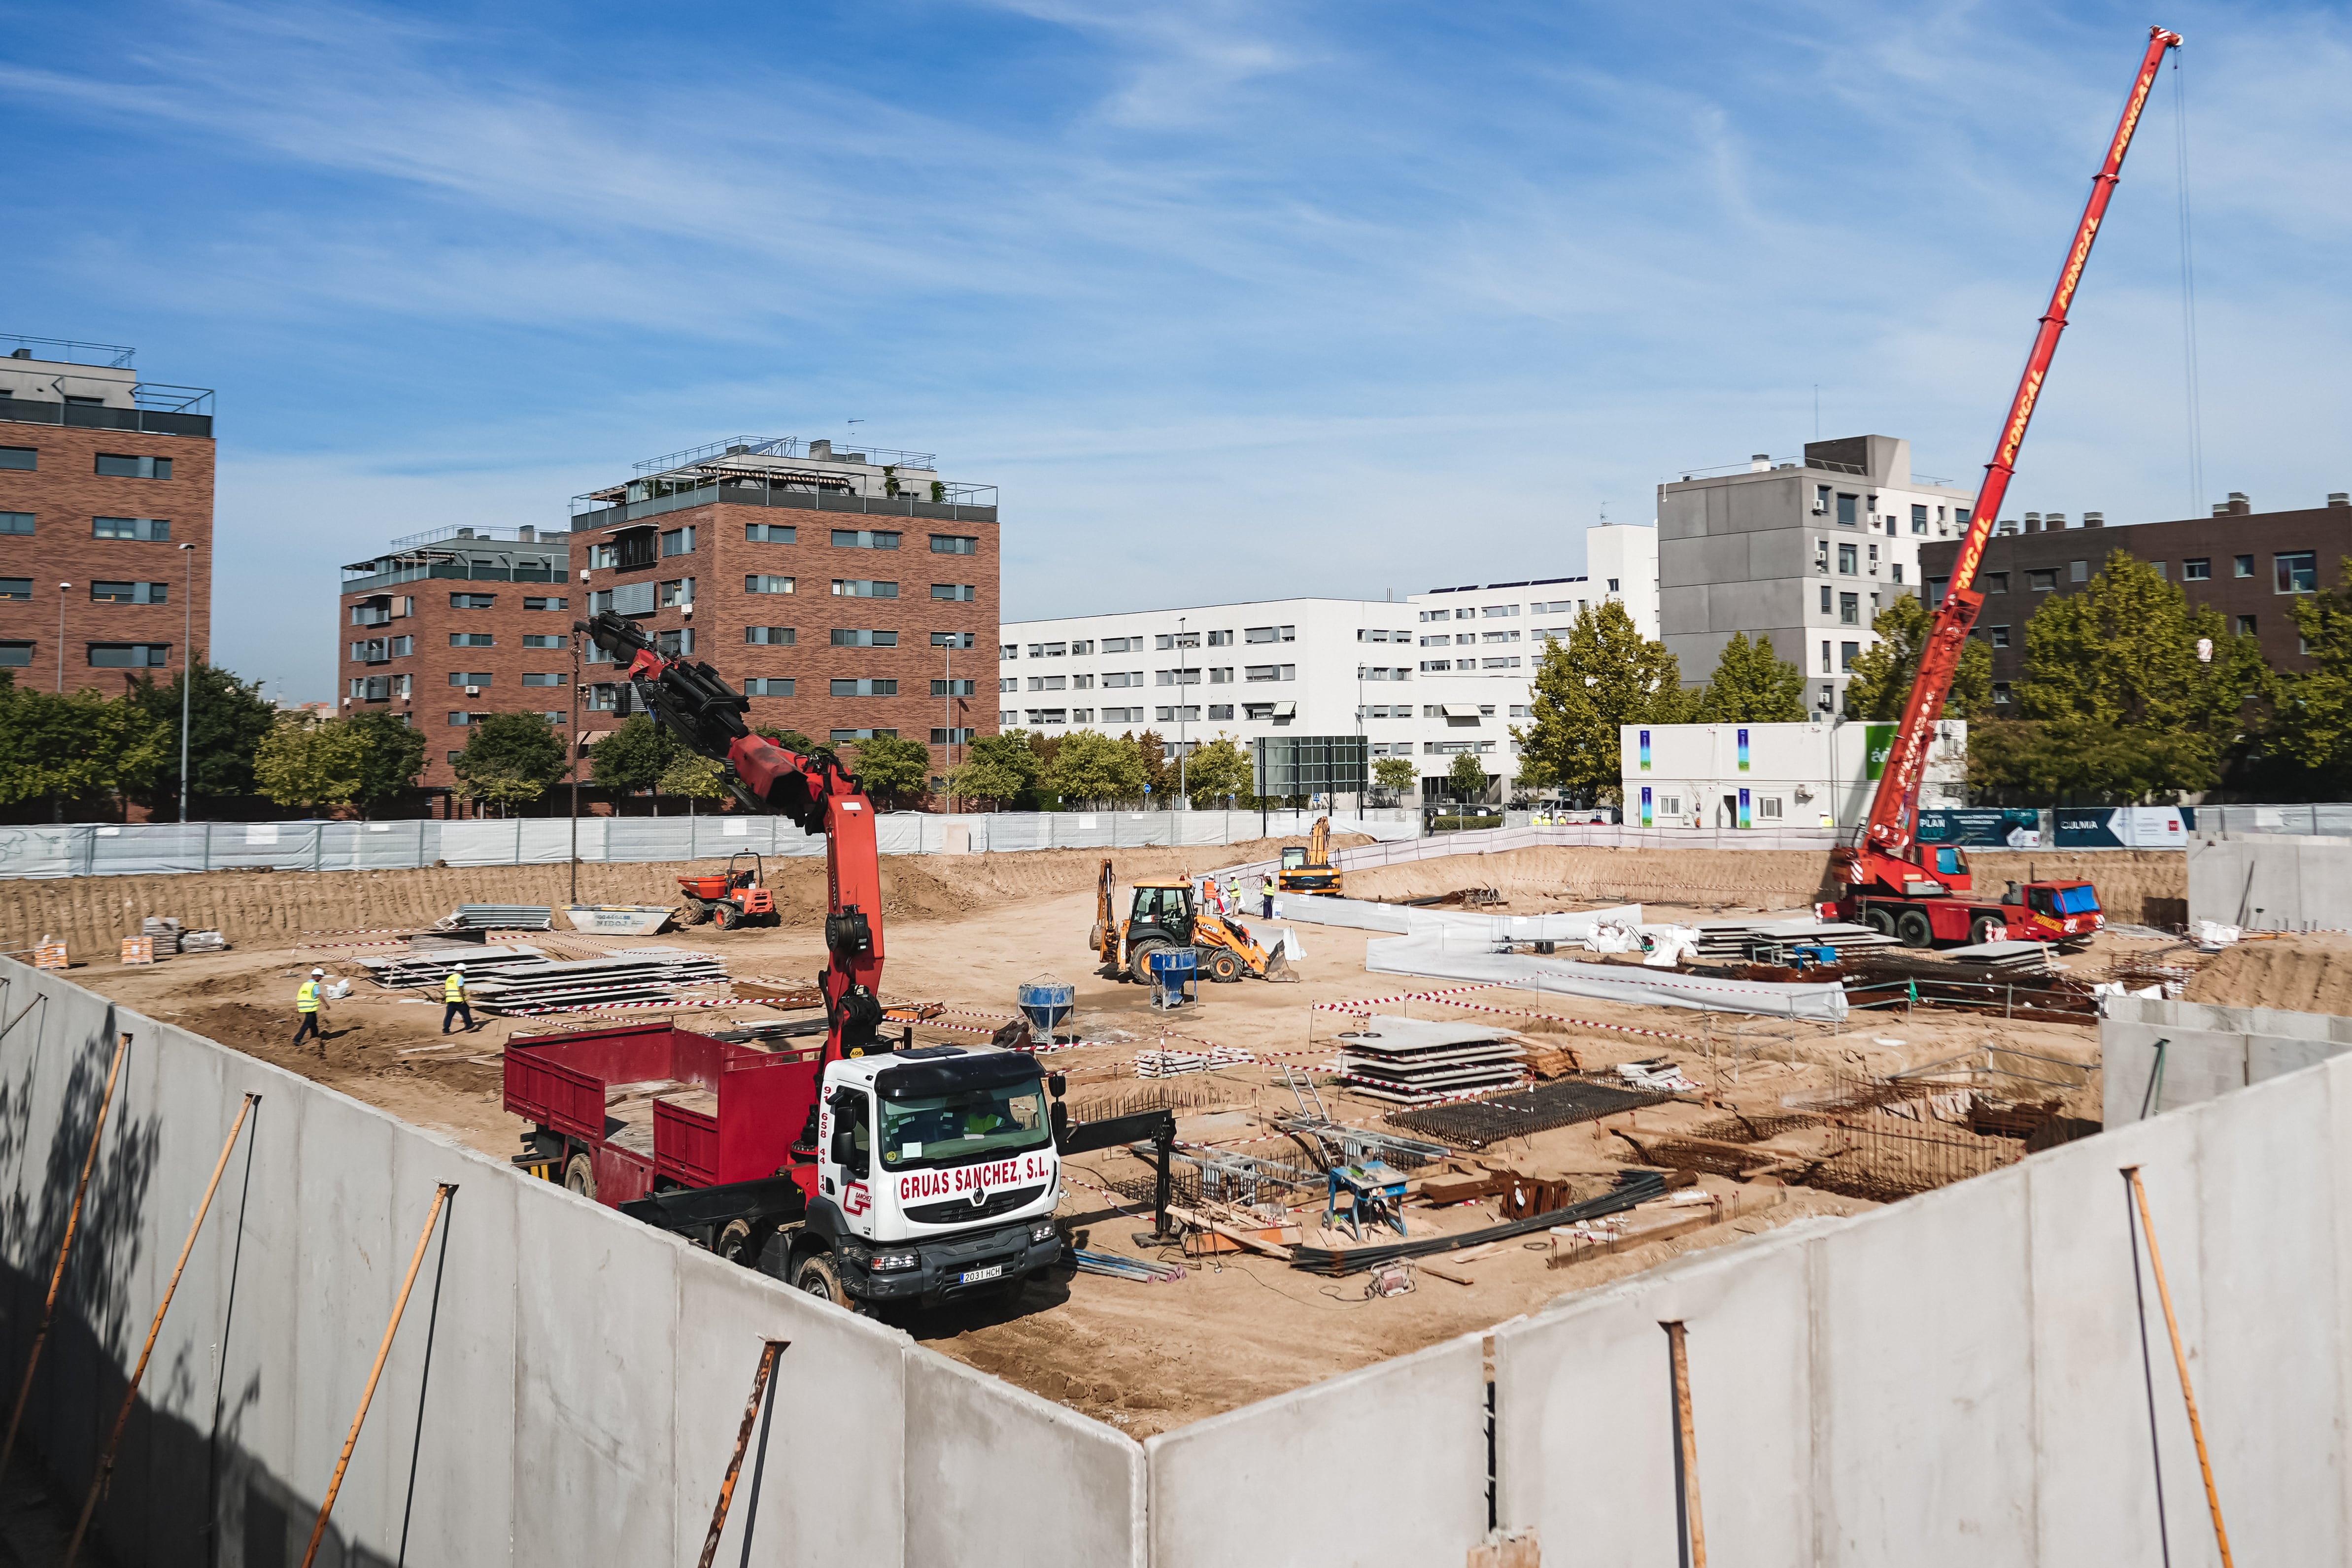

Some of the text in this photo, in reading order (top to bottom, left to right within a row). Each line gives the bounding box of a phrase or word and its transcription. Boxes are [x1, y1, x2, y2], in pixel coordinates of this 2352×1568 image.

[1919, 818, 1945, 828] PLAN
[1920, 828, 1945, 837] VIVE
[1201, 922, 1219, 934] JCB
[819, 1148, 825, 1164] 44
[820, 1175, 825, 1191] 14
[901, 1156, 1049, 1200] GRUAS SANCHEZ, S.L.
[965, 1267, 1000, 1282] 2031 HCH
